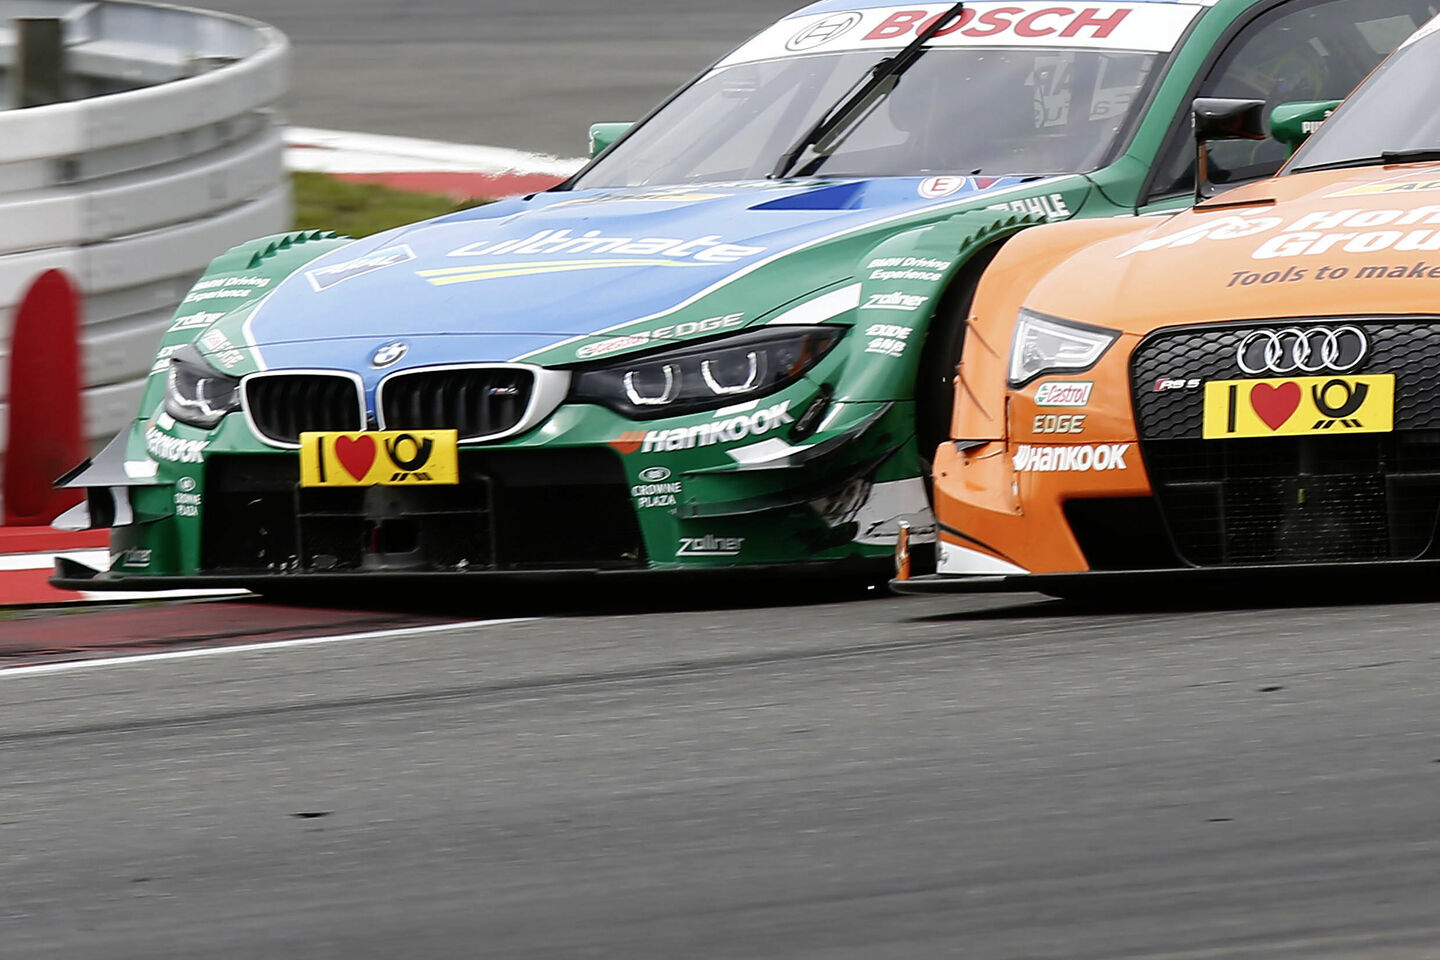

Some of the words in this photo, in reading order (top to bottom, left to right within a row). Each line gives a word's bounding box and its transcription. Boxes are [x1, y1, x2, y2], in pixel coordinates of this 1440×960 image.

[862, 8, 1133, 40] BOSCH
[869, 269, 942, 281] Experience
[902, 257, 952, 271] Driving
[1227, 267, 1306, 288] Tools
[1311, 263, 1347, 281] to
[651, 312, 745, 339] EDGE
[1047, 382, 1089, 404] Castrol
[1227, 385, 1236, 433] I
[1032, 415, 1087, 434] EDGE
[317, 437, 327, 483] I
[631, 482, 682, 497] CROWNE
[638, 495, 677, 508] PLAZA
